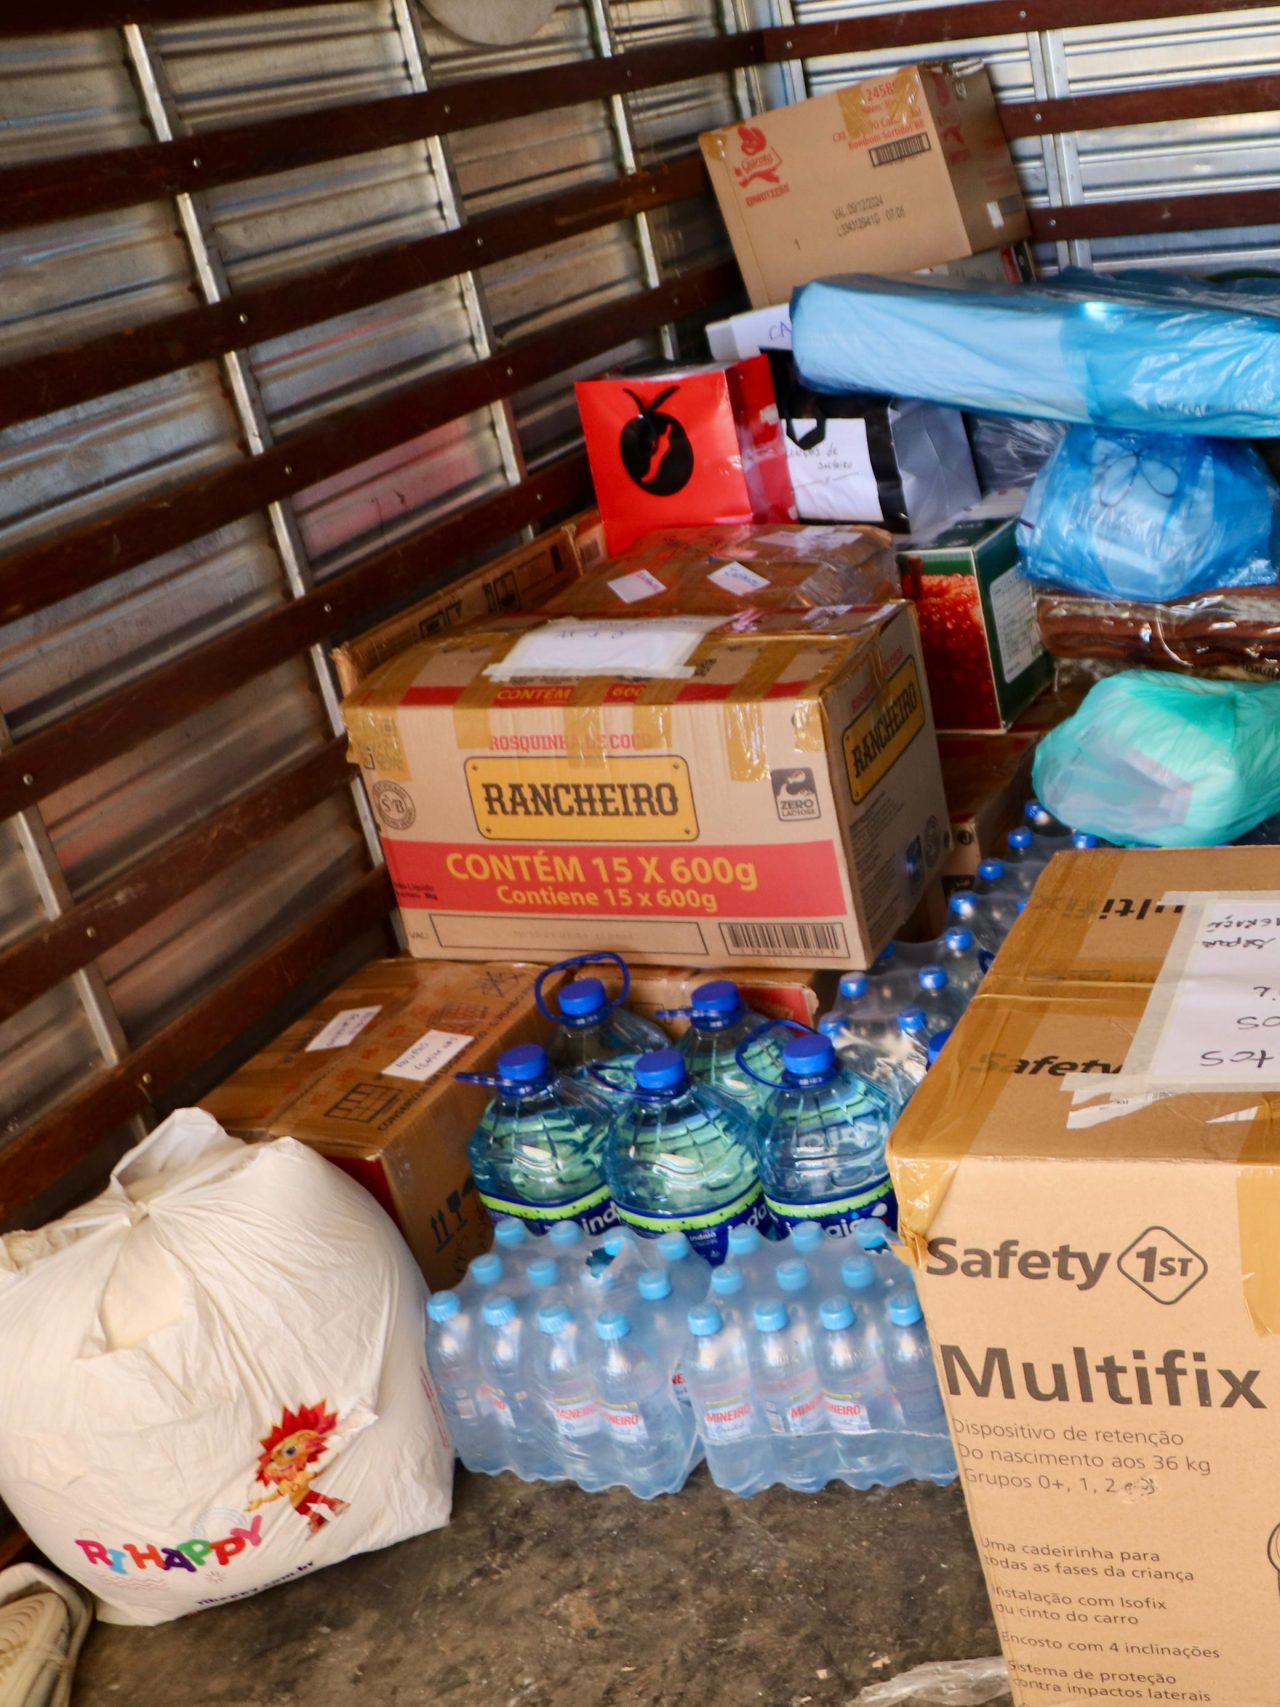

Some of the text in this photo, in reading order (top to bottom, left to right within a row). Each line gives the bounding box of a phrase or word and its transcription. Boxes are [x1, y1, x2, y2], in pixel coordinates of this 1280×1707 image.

[852, 681, 918, 779] RANCHEIRO
[481, 782, 679, 817] RANCHEIRO
[780, 799, 815, 810] ZERO
[446, 850, 586, 883] CONTÉM
[592, 856, 633, 884] 15
[671, 857, 758, 892] 600g
[496, 885, 599, 907] Contiene
[604, 888, 633, 907] 15
[656, 889, 719, 913] 600g
[926, 1236, 1112, 1291] Safety
[940, 1344, 1268, 1409] Multifix
[952, 1418, 1185, 1448] Dispositivo de retenção
[957, 1443, 1211, 1476] Do nascimento aos 36 kg
[963, 1468, 1033, 1492] Grupos
[1038, 1473, 1071, 1494] 0+,
[1079, 1476, 1098, 1495] 1,
[1104, 1477, 1116, 1493] 2
[1021, 1542, 1115, 1561] cadeirinha
[1119, 1550, 1161, 1564] para
[1033, 1563, 1053, 1575] as
[1055, 1561, 1099, 1578] fases
[1103, 1565, 1127, 1579] da
[1131, 1568, 1195, 1583] criança
[1018, 1605, 1062, 1622] cinto
[1066, 1610, 1090, 1624] do
[1094, 1613, 1139, 1626] carro
[1078, 1595, 1116, 1607] com
[1120, 1596, 1168, 1611] Isofix
[1001, 1630, 1221, 1660] Encosto com 4 inclinações
[1007, 1659, 1178, 1688] Sistema de proteção
[1067, 1682, 1144, 1701] impactos
[1148, 1687, 1212, 1703] laterais
